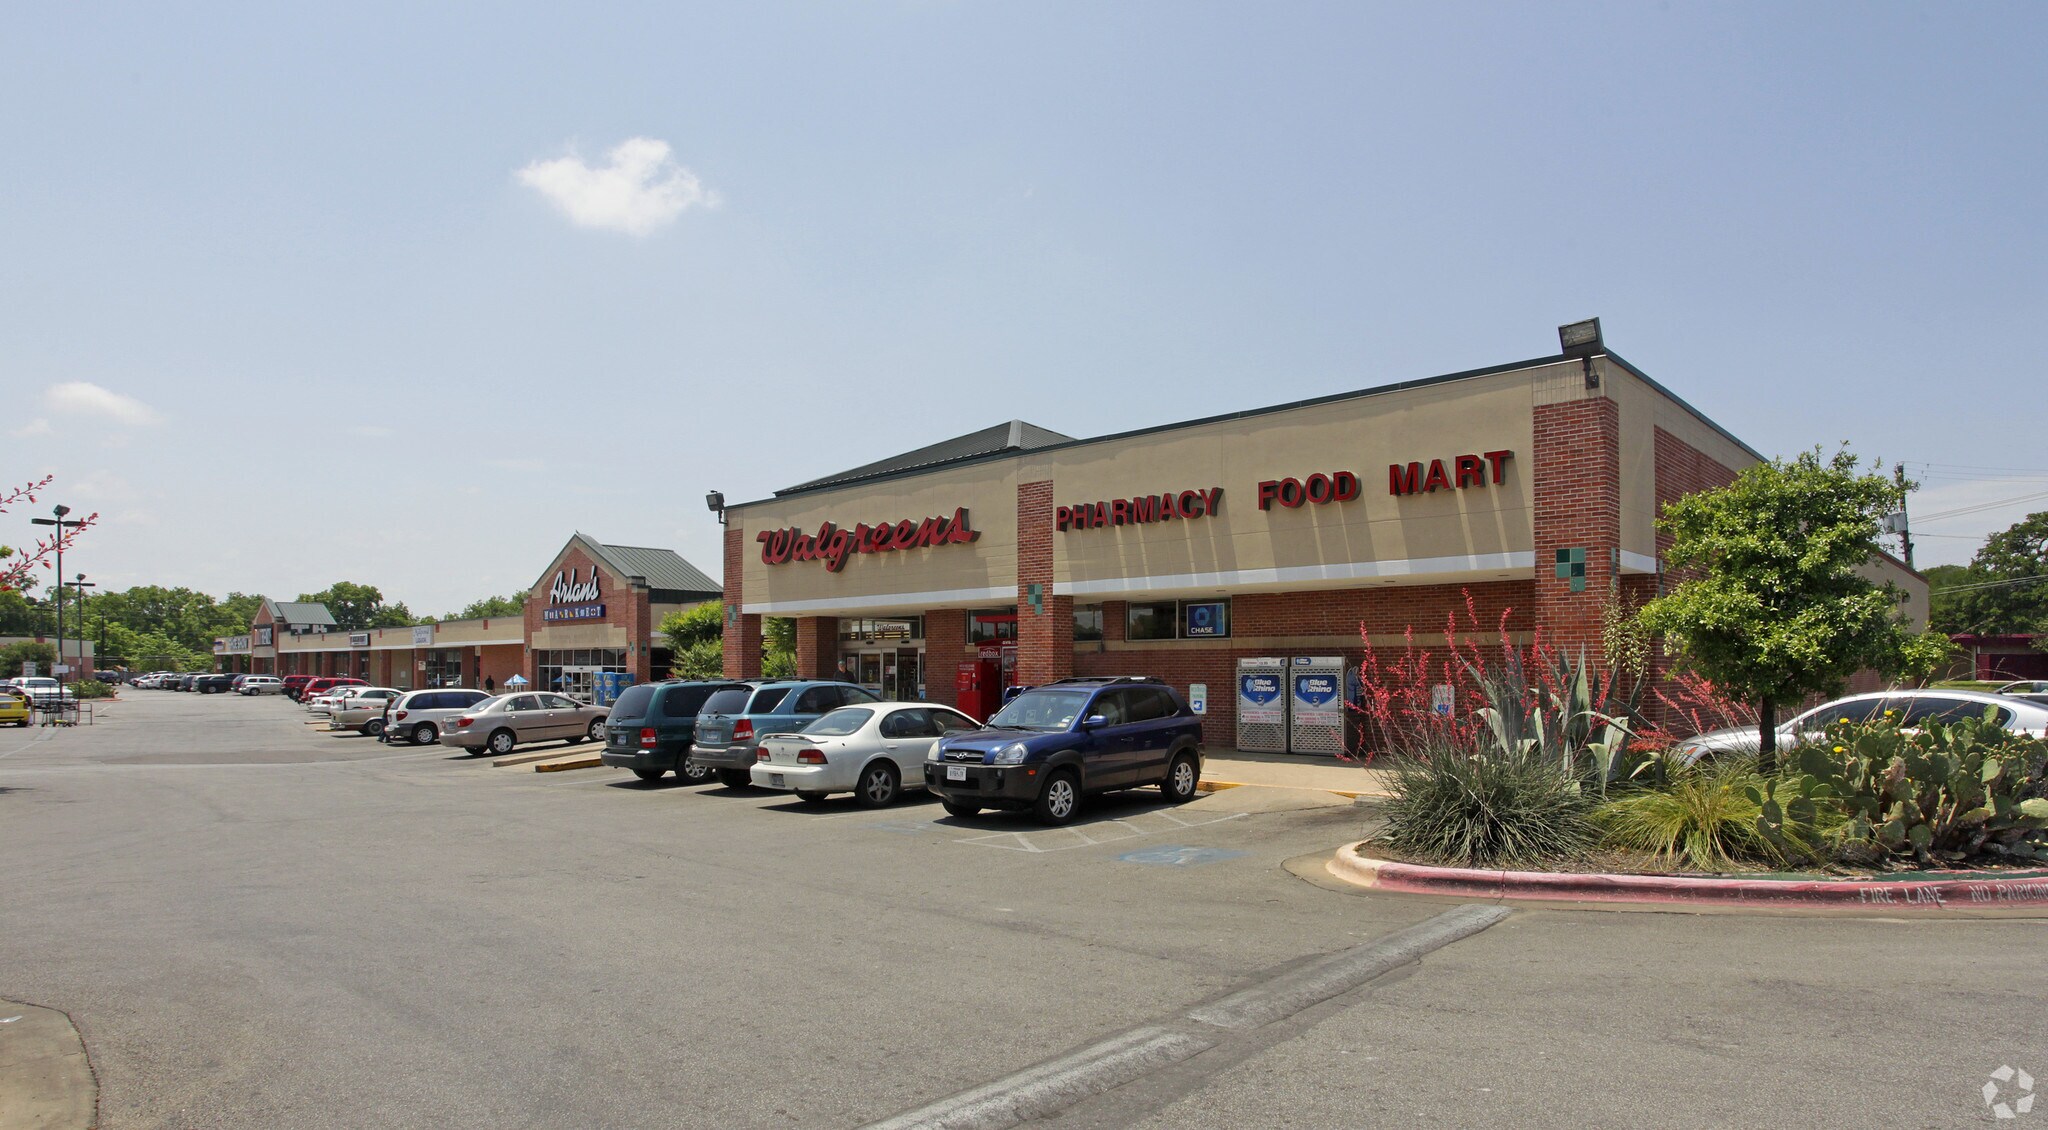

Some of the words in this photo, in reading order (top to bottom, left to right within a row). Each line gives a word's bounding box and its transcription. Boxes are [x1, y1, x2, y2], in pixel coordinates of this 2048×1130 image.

[1056, 486, 1224, 532] PHARMACY
[1258, 470, 1360, 511] FOOD
[1389, 449, 1514, 496] MART
[756, 507, 980, 572] Walgreens
[549, 565, 600, 604] Arlan's
[1191, 626, 1213, 634] CHASE
[1860, 887, 1897, 904] FIRE
[1904, 886, 1947, 904] LANE
[1969, 885, 1992, 903] NO
